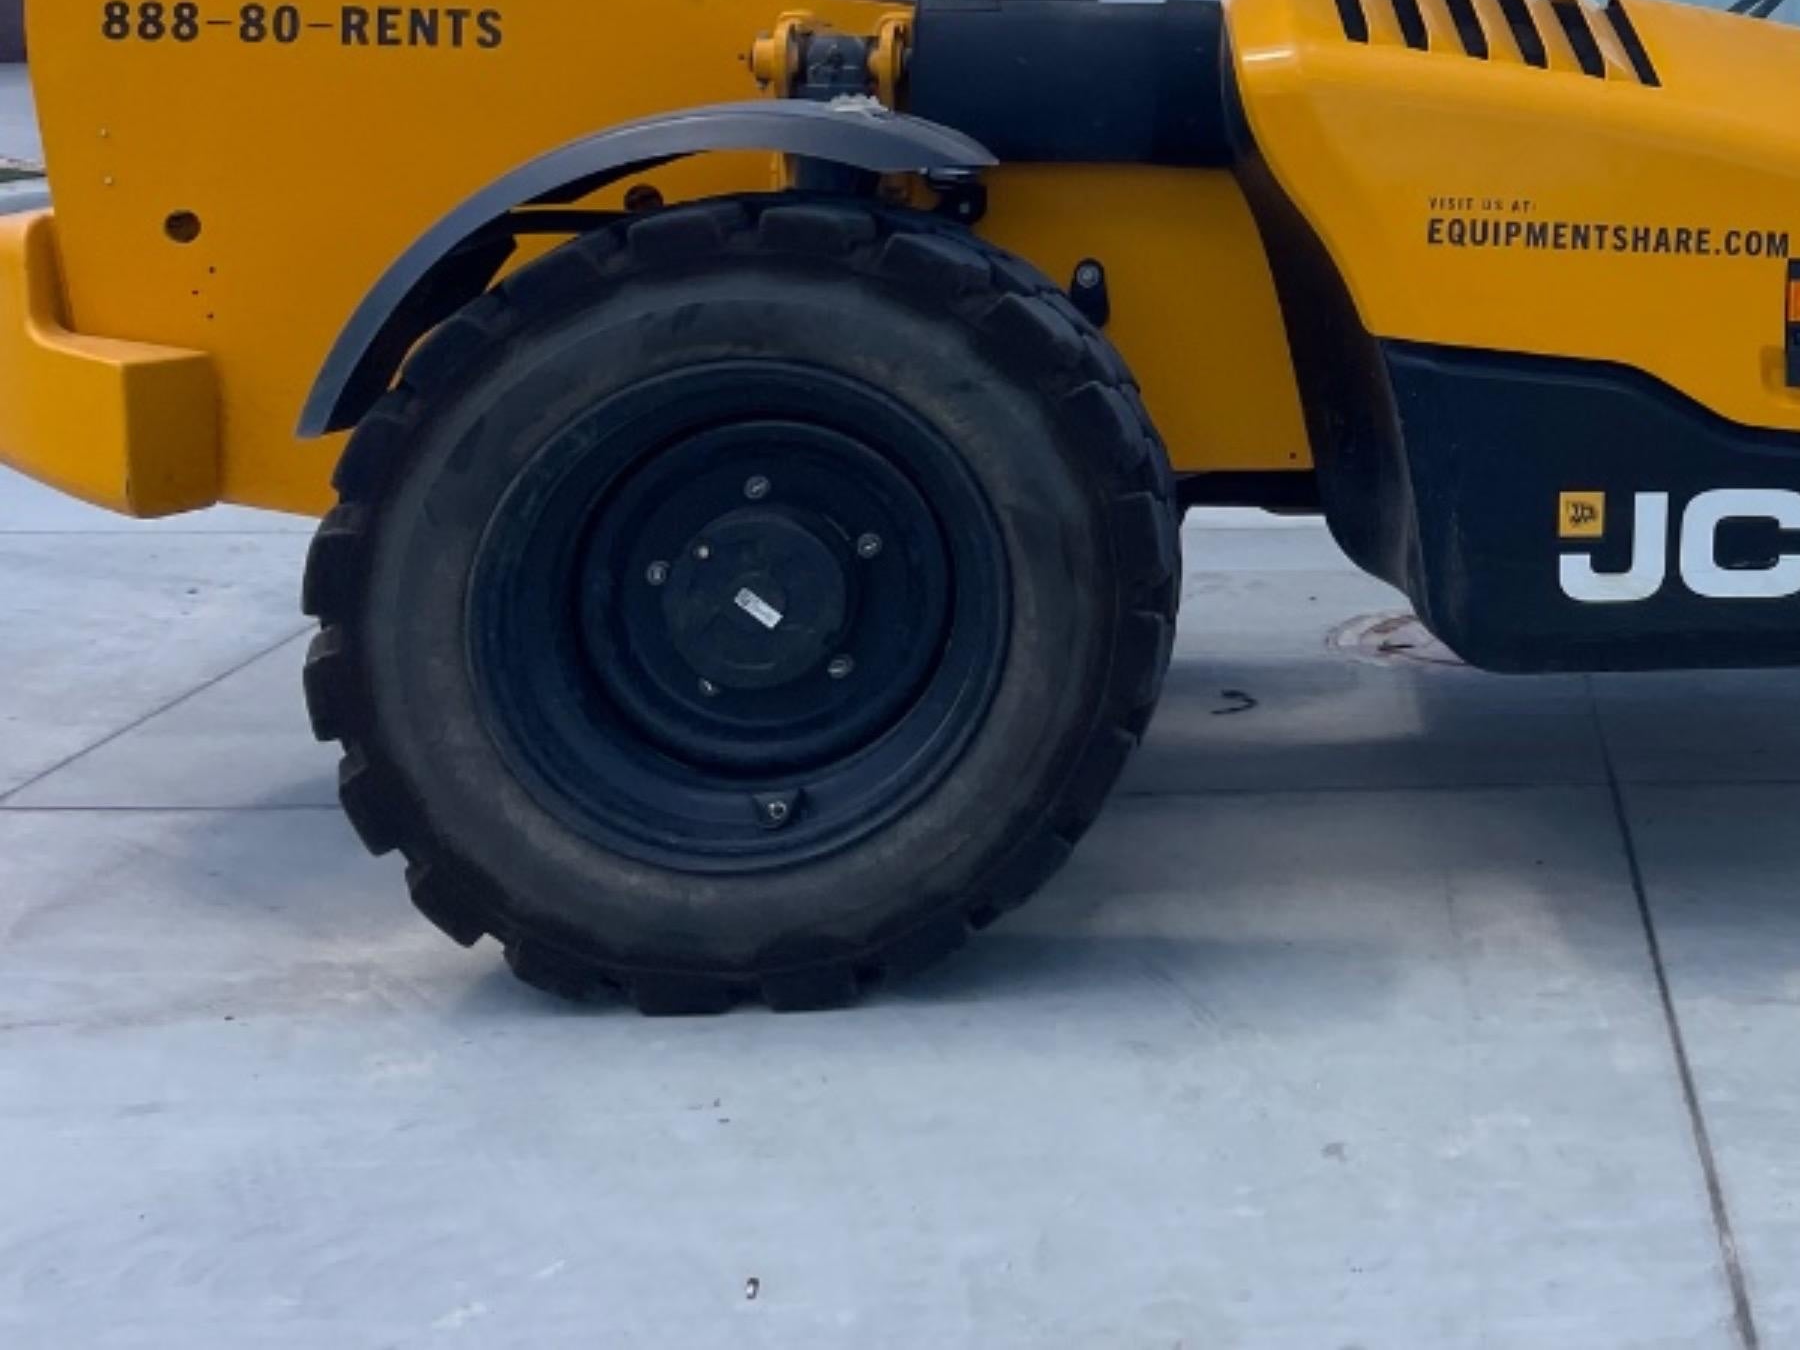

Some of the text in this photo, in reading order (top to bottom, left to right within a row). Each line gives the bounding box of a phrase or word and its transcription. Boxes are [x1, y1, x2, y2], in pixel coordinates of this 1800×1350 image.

[101, 0, 503, 49] 888-80-RENTS
[1429, 197, 1474, 211] VISIT
[1482, 198, 1504, 211] US
[1427, 217, 1791, 259] EQUIPMENTSHARE.COM
